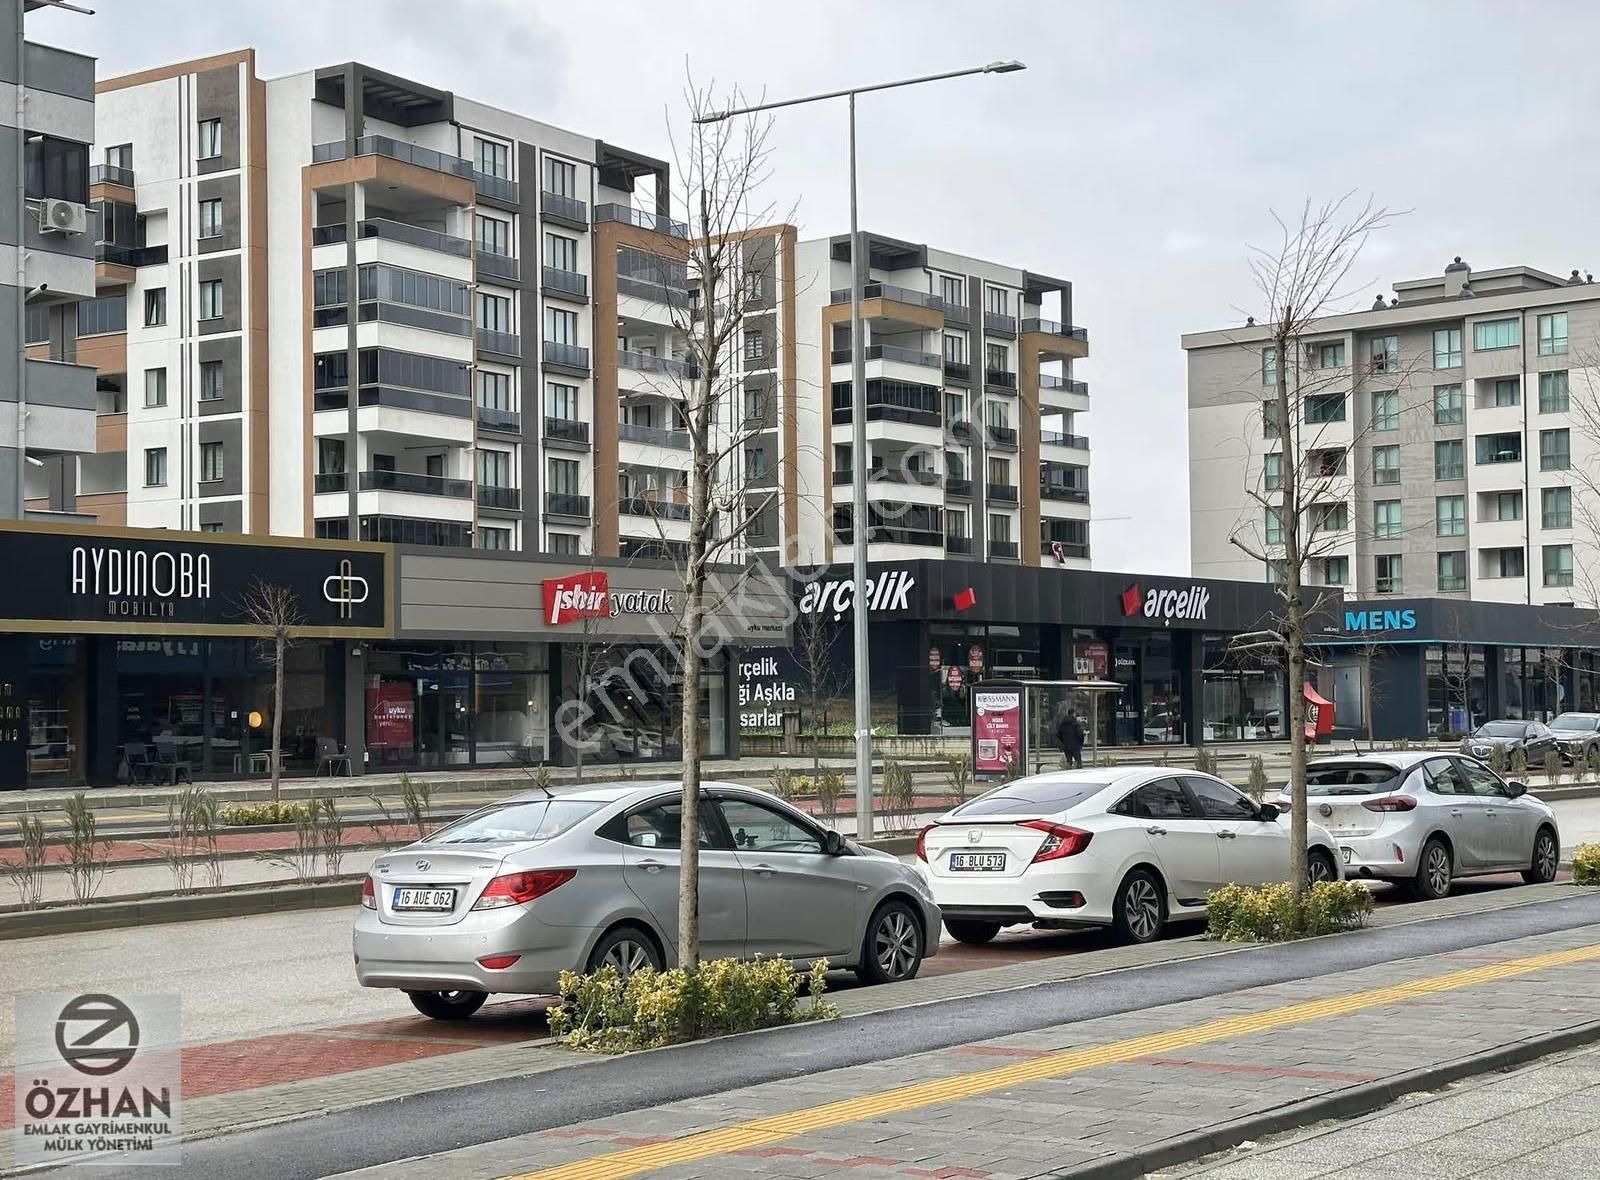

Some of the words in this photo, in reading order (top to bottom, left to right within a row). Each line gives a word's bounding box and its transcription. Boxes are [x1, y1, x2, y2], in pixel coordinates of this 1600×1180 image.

[72, 547, 210, 598] AYDINOBA
[108, 600, 174, 616] MOBILYA
[609, 588, 673, 618] yatak
[1144, 586, 1210, 627] arçelik
[1345, 609, 1416, 631] MENS
[739, 657, 778, 681] rçelik
[754, 682, 795, 706] Aşkla
[977, 695, 1017, 703] ROSSMANN
[740, 708, 782, 726] sarlar
[956, 856, 964, 866] 16
[969, 856, 984, 867] BLU
[987, 856, 1003, 867] 573
[400, 890, 410, 905] 16
[413, 891, 431, 905] AUE
[434, 892, 451, 906] 062
